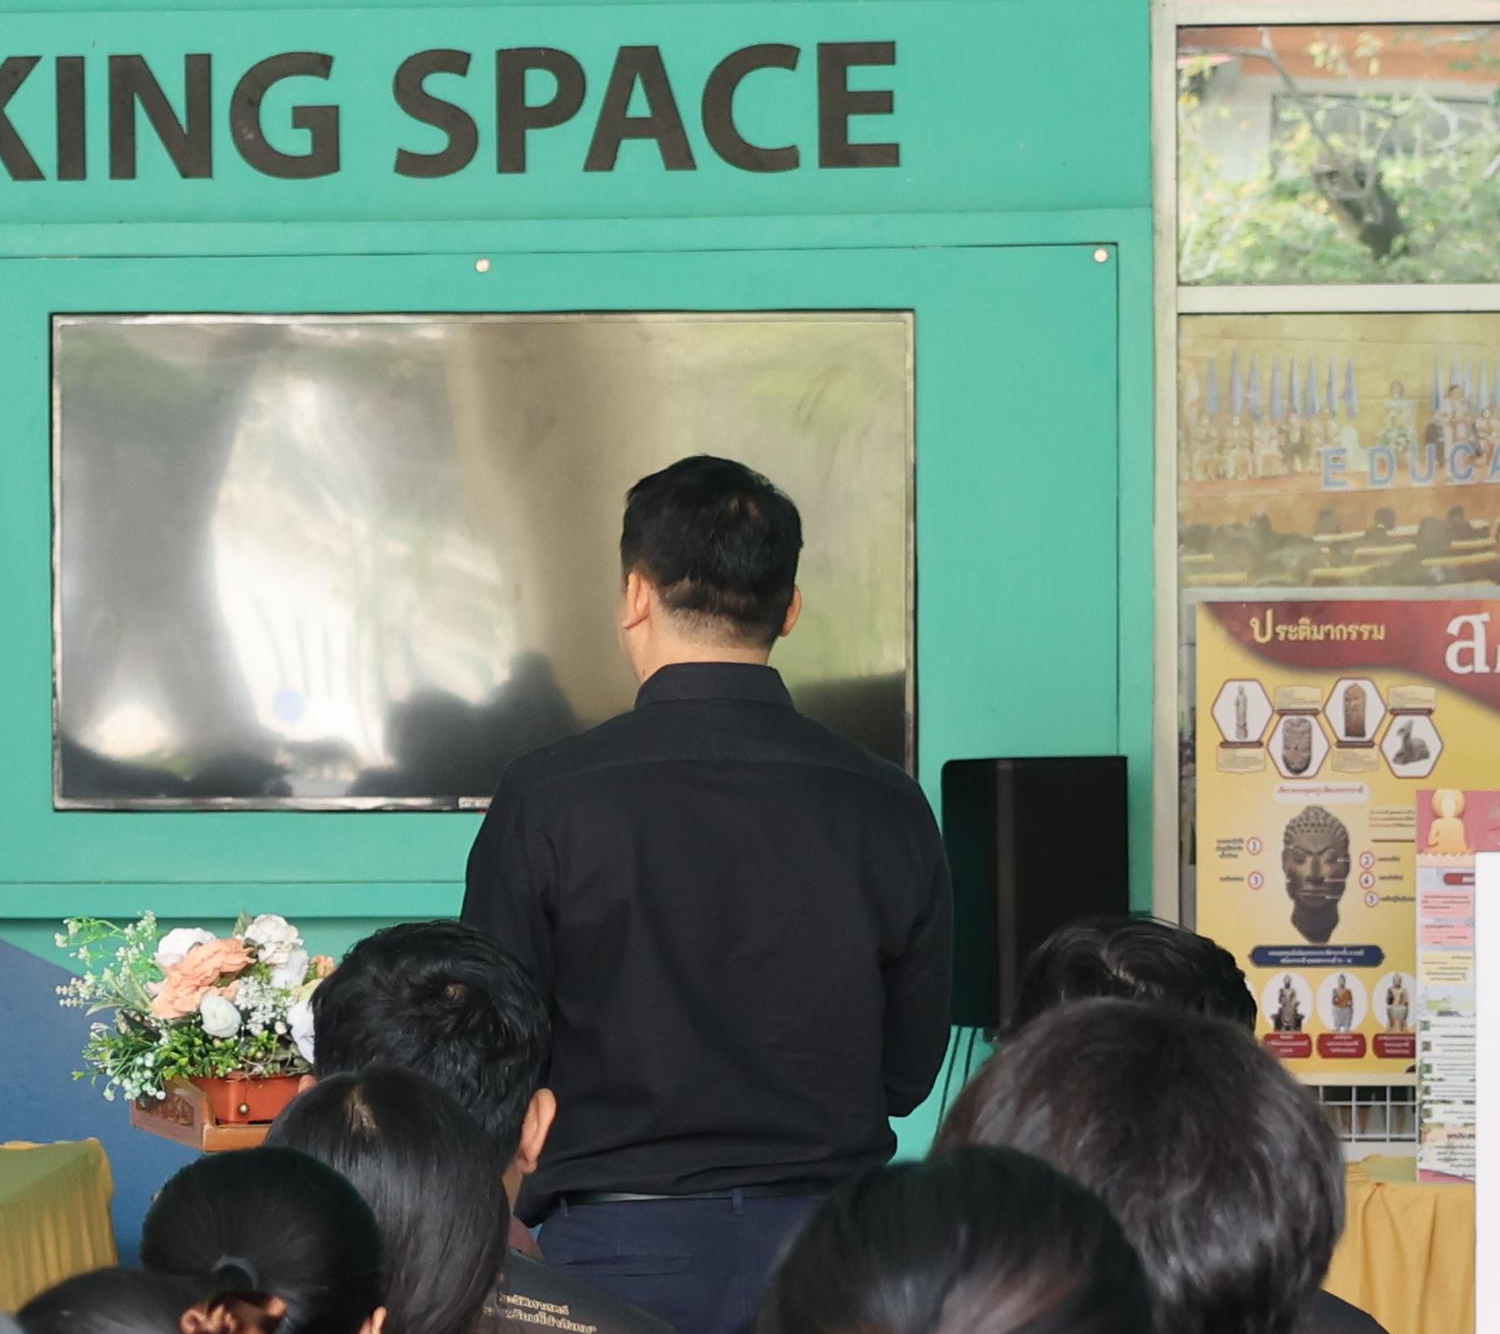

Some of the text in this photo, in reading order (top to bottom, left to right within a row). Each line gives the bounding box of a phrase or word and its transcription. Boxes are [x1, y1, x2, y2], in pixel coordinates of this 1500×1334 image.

[390, 39, 901, 181] SPACE
[1250, 610, 1385, 645] ประติมากรรม
